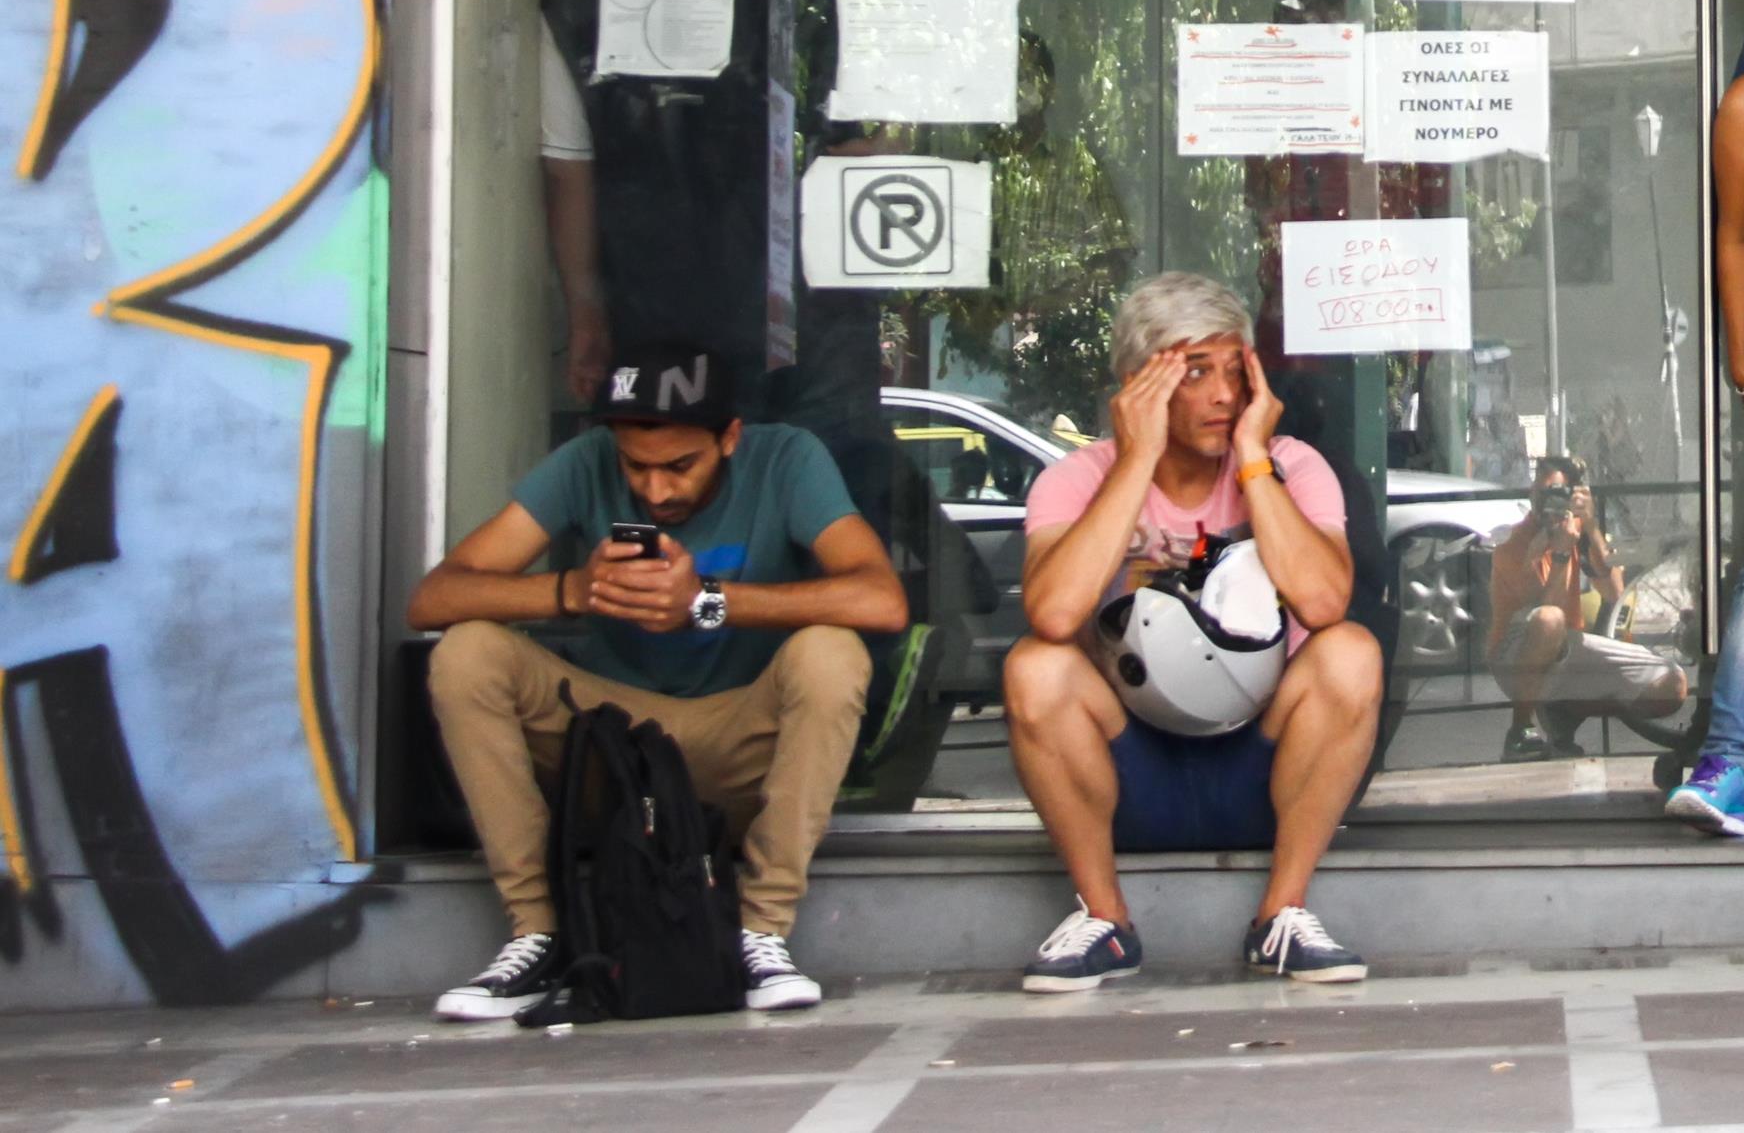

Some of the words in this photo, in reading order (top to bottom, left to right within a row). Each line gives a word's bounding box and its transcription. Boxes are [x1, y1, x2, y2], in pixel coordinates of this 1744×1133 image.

[1420, 41, 1464, 55] ΟΛΕΣ
[1470, 41, 1490, 54] ΟΙ
[1402, 69, 1510, 84] ΣΥΝΑΛΛΑΓΕΣ
[1399, 98, 1483, 112] ΓΙΝΟΝΤΑΙ
[1489, 98, 1513, 111] ΜΕ
[1415, 127, 1499, 140] ΝΟΥΜΕΡΟ
[1304, 256, 1439, 288] ΕΙΣΟΔΟΥ
